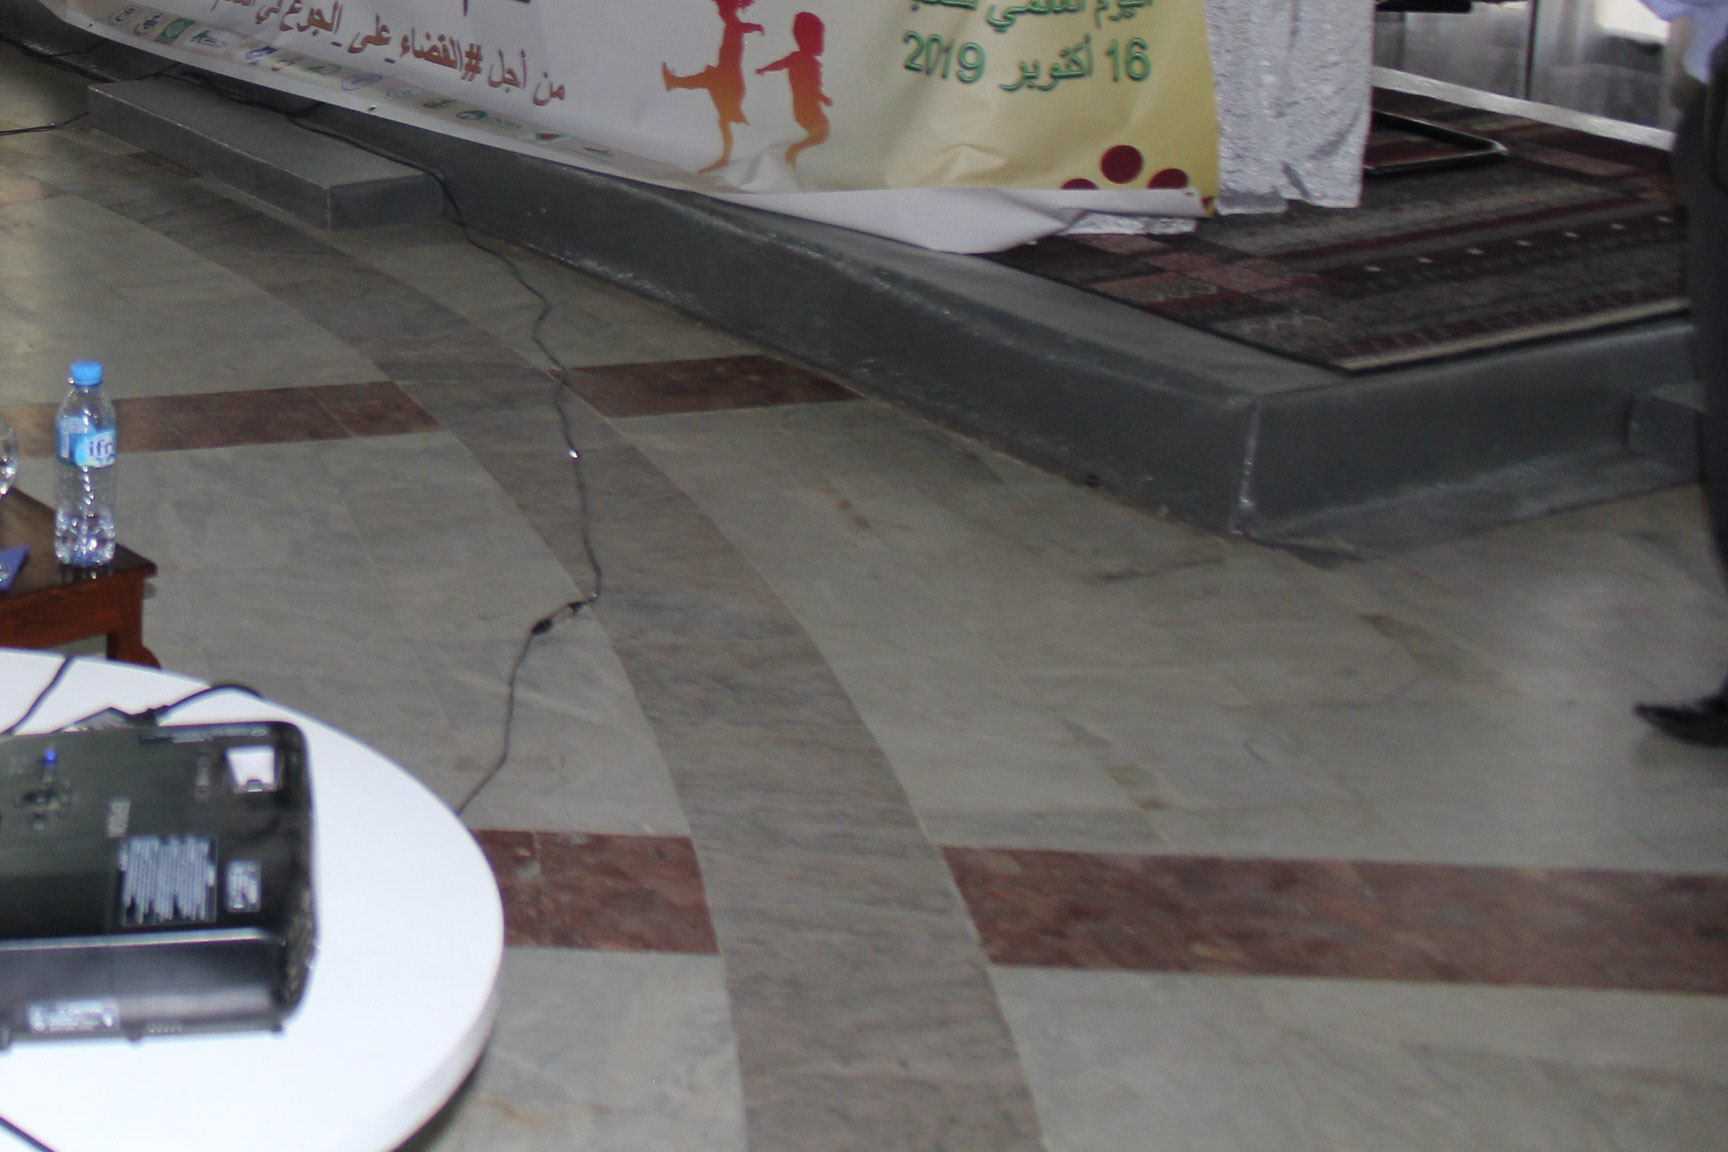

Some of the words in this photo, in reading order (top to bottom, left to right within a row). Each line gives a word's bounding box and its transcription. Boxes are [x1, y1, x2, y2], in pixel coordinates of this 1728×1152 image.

[487, 47, 528, 93] أجل
[903, 30, 986, 85] 2019
[999, 33, 1095, 92] أكتوبر
[1105, 37, 1151, 83] 16
[532, 70, 566, 107] من
